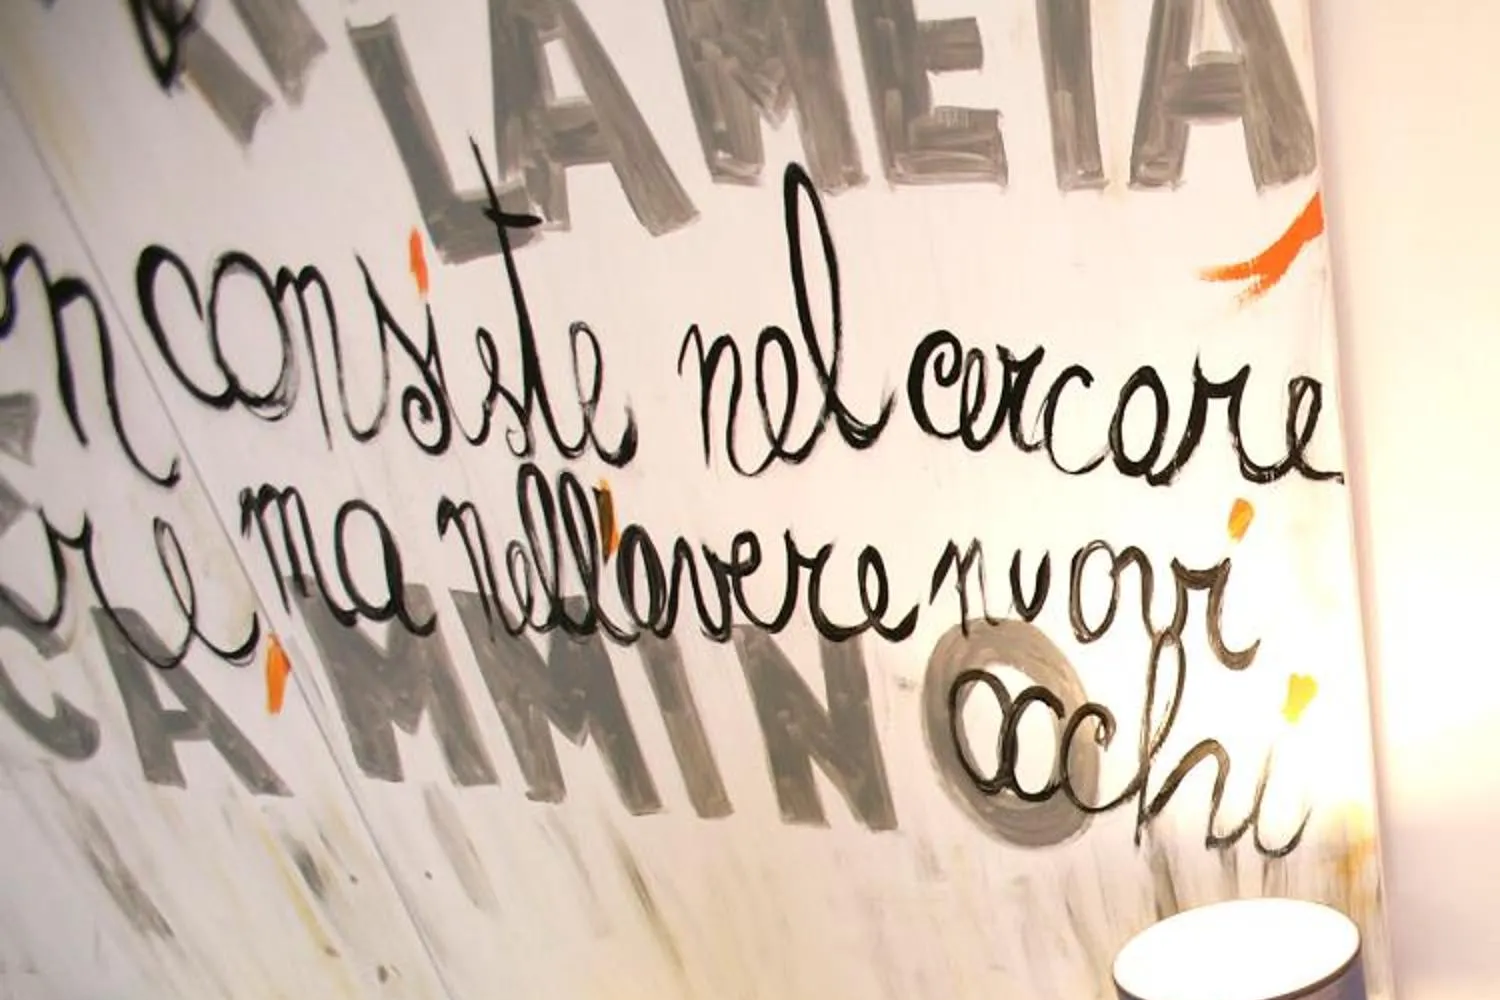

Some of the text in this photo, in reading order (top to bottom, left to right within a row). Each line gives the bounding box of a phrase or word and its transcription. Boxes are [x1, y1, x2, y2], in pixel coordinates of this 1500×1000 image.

[135, 130, 638, 469] consiste
[678, 161, 896, 479] nel
[907, 329, 1346, 487] cercare
[239, 482, 438, 642] ma
